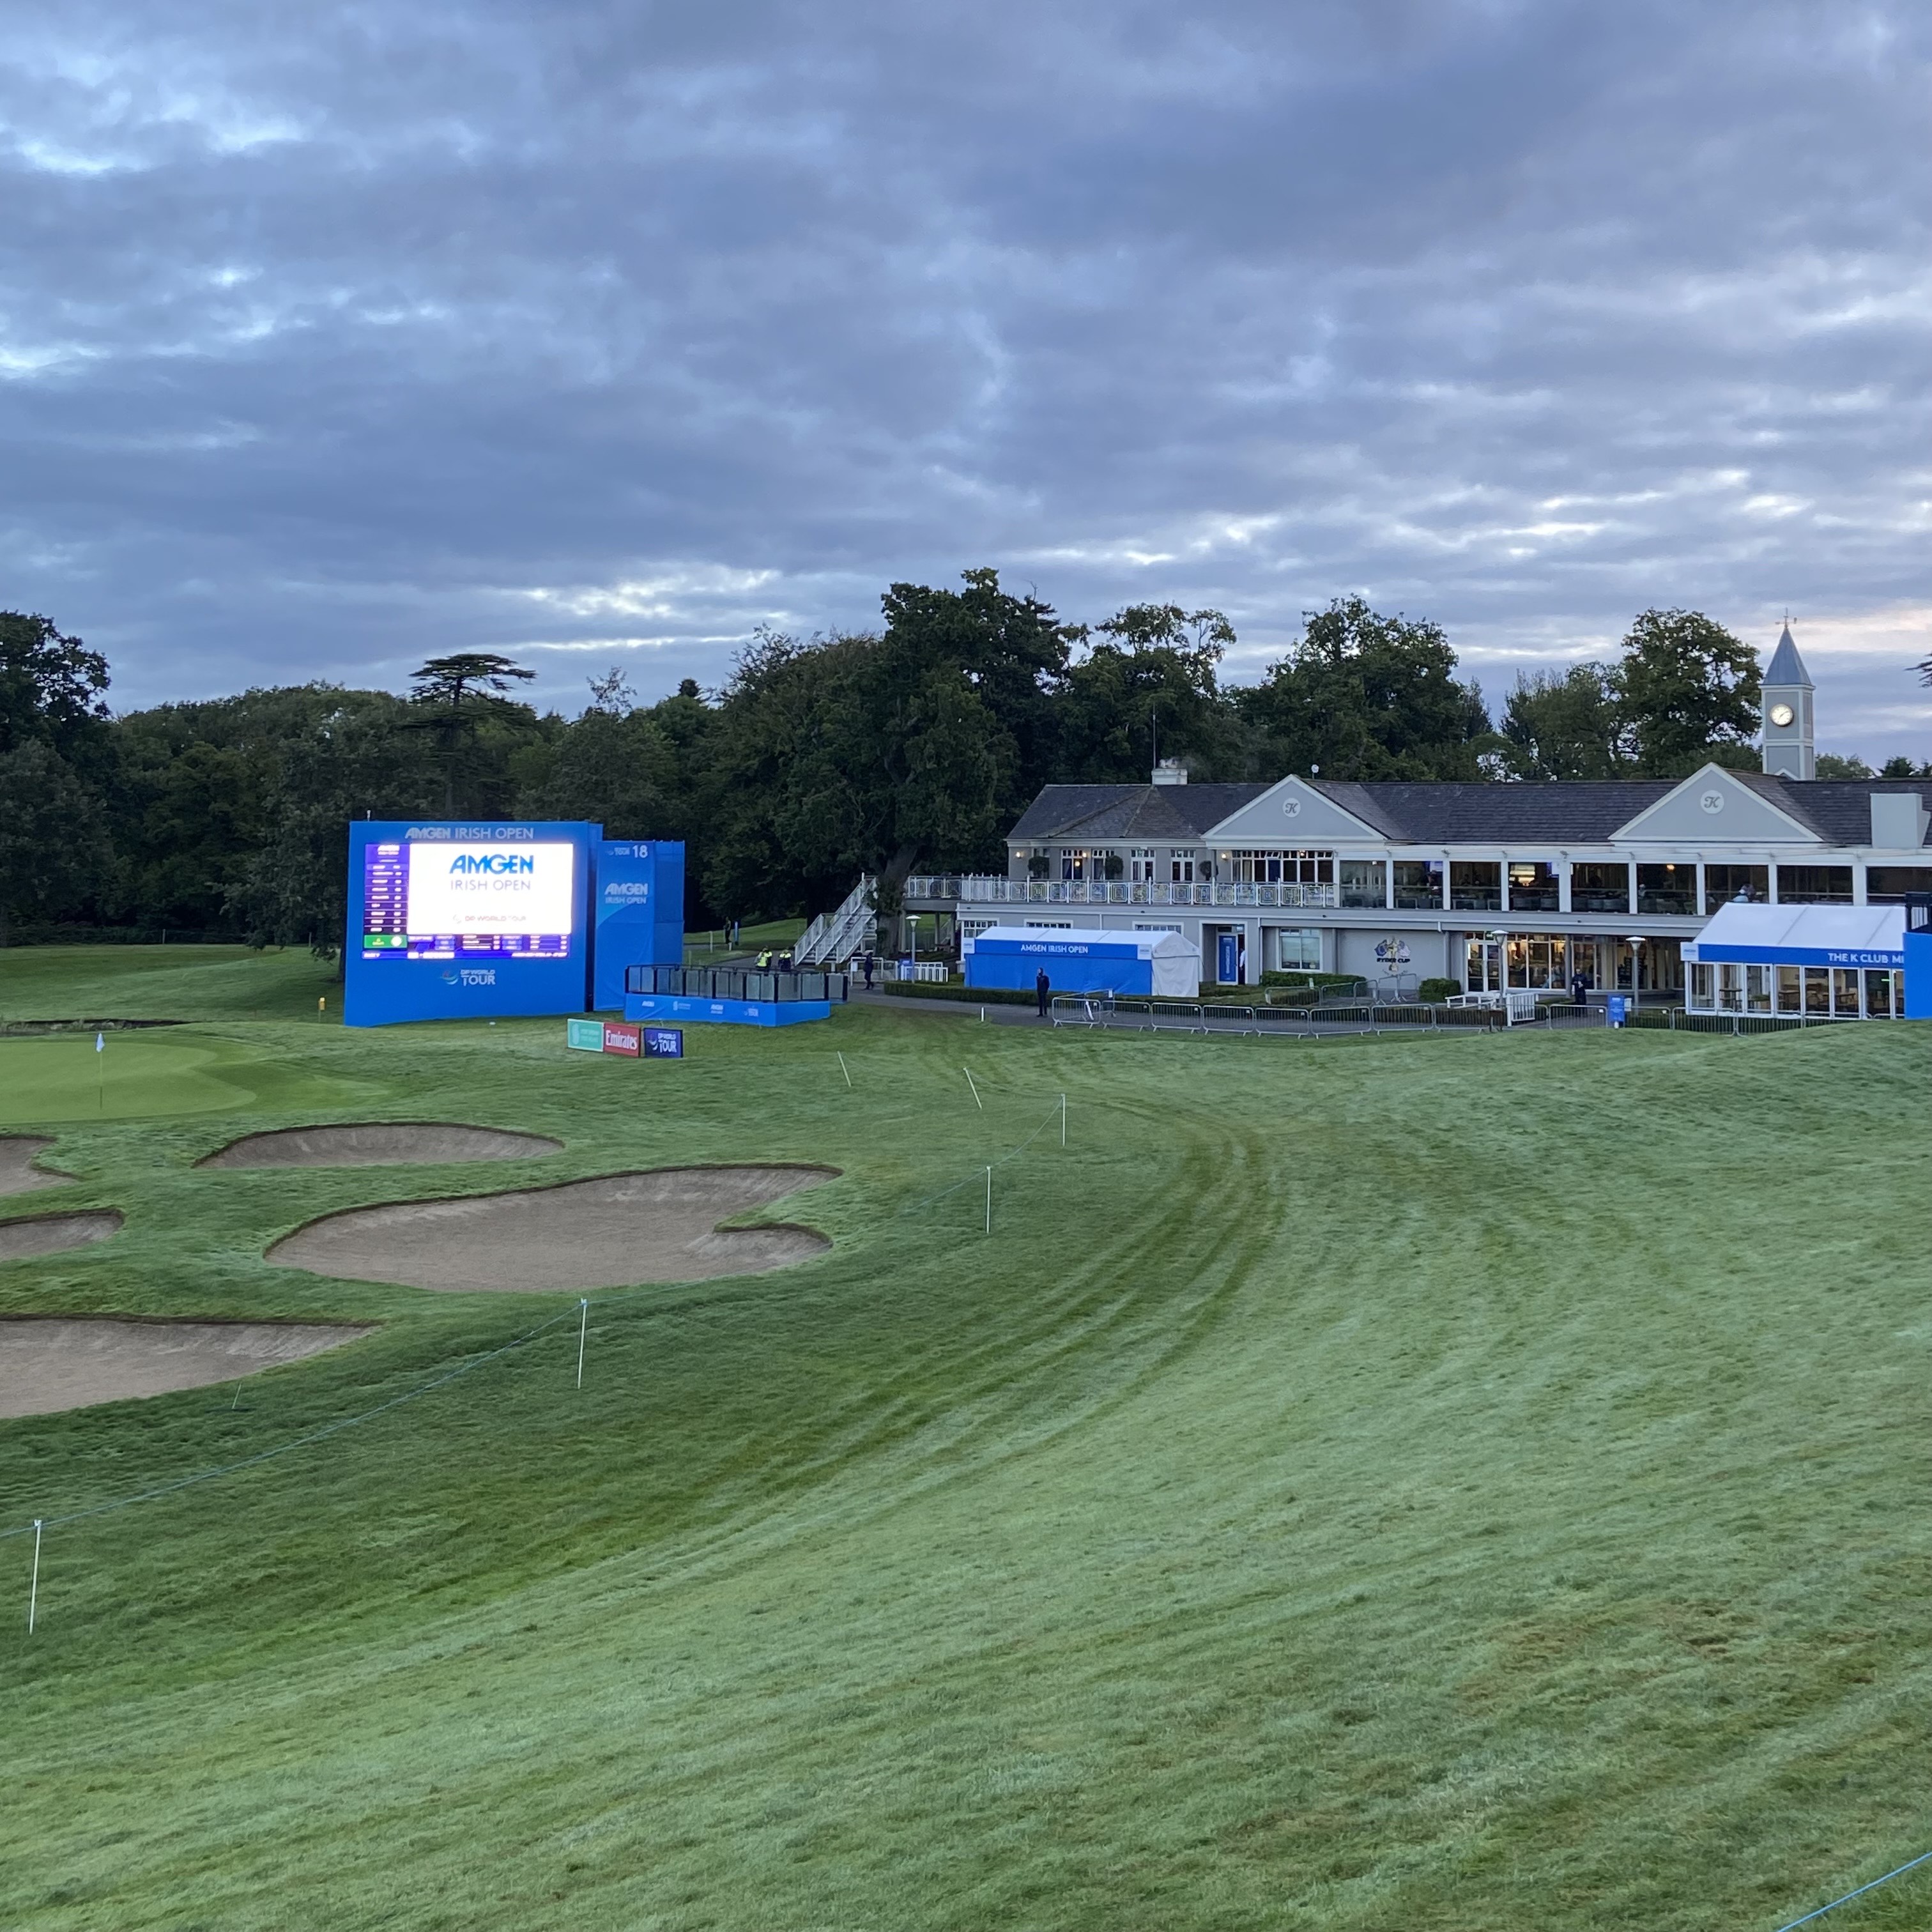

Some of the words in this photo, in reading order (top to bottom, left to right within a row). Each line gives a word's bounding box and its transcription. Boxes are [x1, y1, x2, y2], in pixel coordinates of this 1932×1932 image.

[405, 827, 450, 839] AMGEN
[455, 827, 491, 839] IRISH
[495, 827, 533, 839] OPEN
[632, 845, 648, 858] 18
[449, 854, 533, 875] AMGEN
[450, 879, 487, 891] IRISH
[493, 879, 530, 891] OPEN
[604, 883, 648, 895] AMGEN
[1020, 944, 1047, 953] AMGEN
[1048, 945, 1067, 953] IRISH
[1068, 946, 1088, 954] OPEN
[1828, 953, 1848, 962] THE
[1850, 954, 1858, 962] K
[1860, 954, 1889, 963] CLUB
[461, 974, 496, 986] TOUR
[606, 1029, 637, 1050] Emirates
[658, 1039, 677, 1053] TOUR
